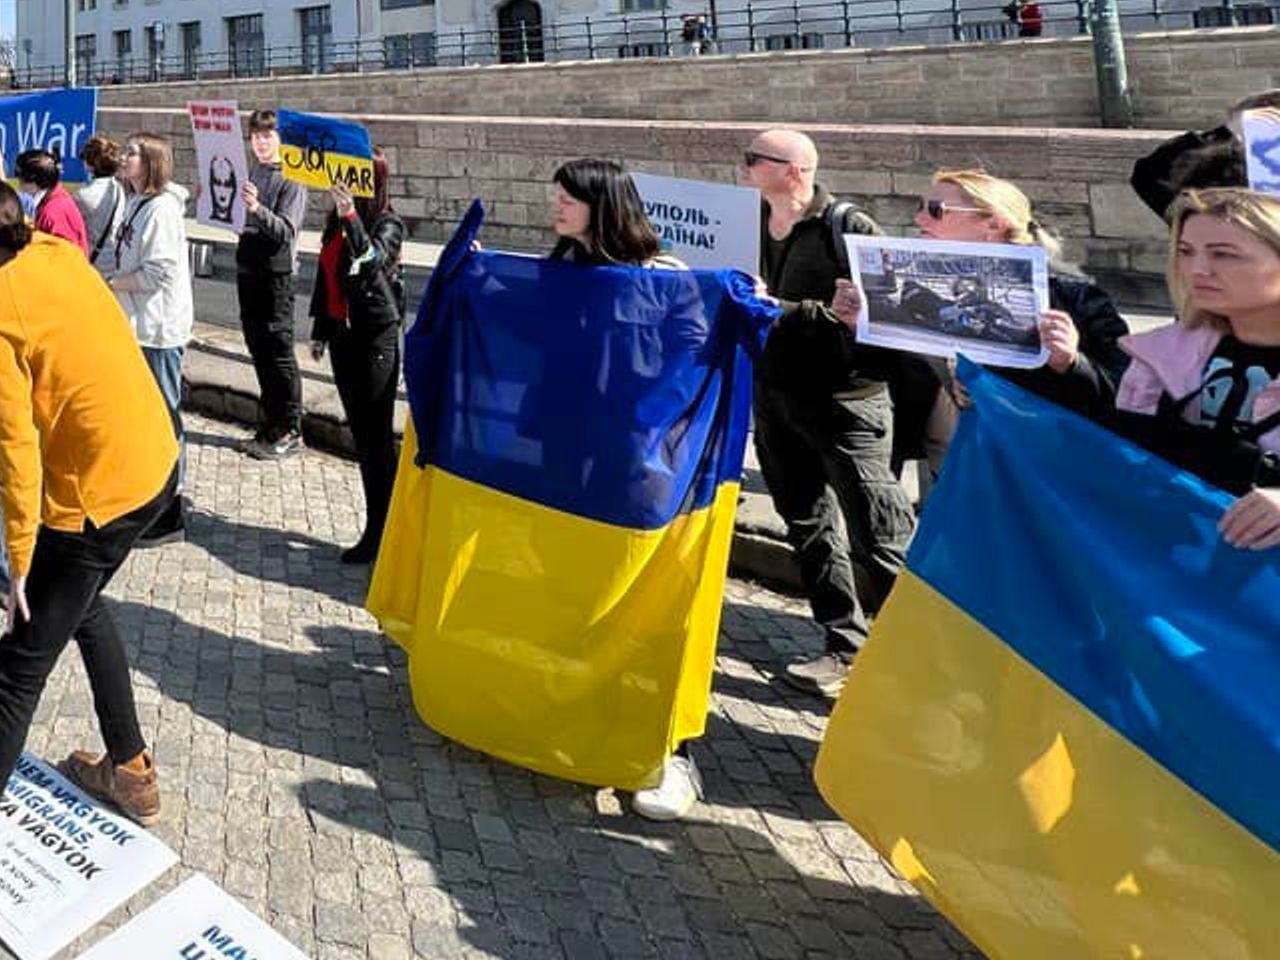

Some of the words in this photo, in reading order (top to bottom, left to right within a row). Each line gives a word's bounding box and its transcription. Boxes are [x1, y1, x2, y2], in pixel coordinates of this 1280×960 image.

[16, 109, 85, 158] War
[326, 157, 374, 191] WAR
[16, 756, 54, 789] NEM
[51, 788, 136, 847] VAGYOK
